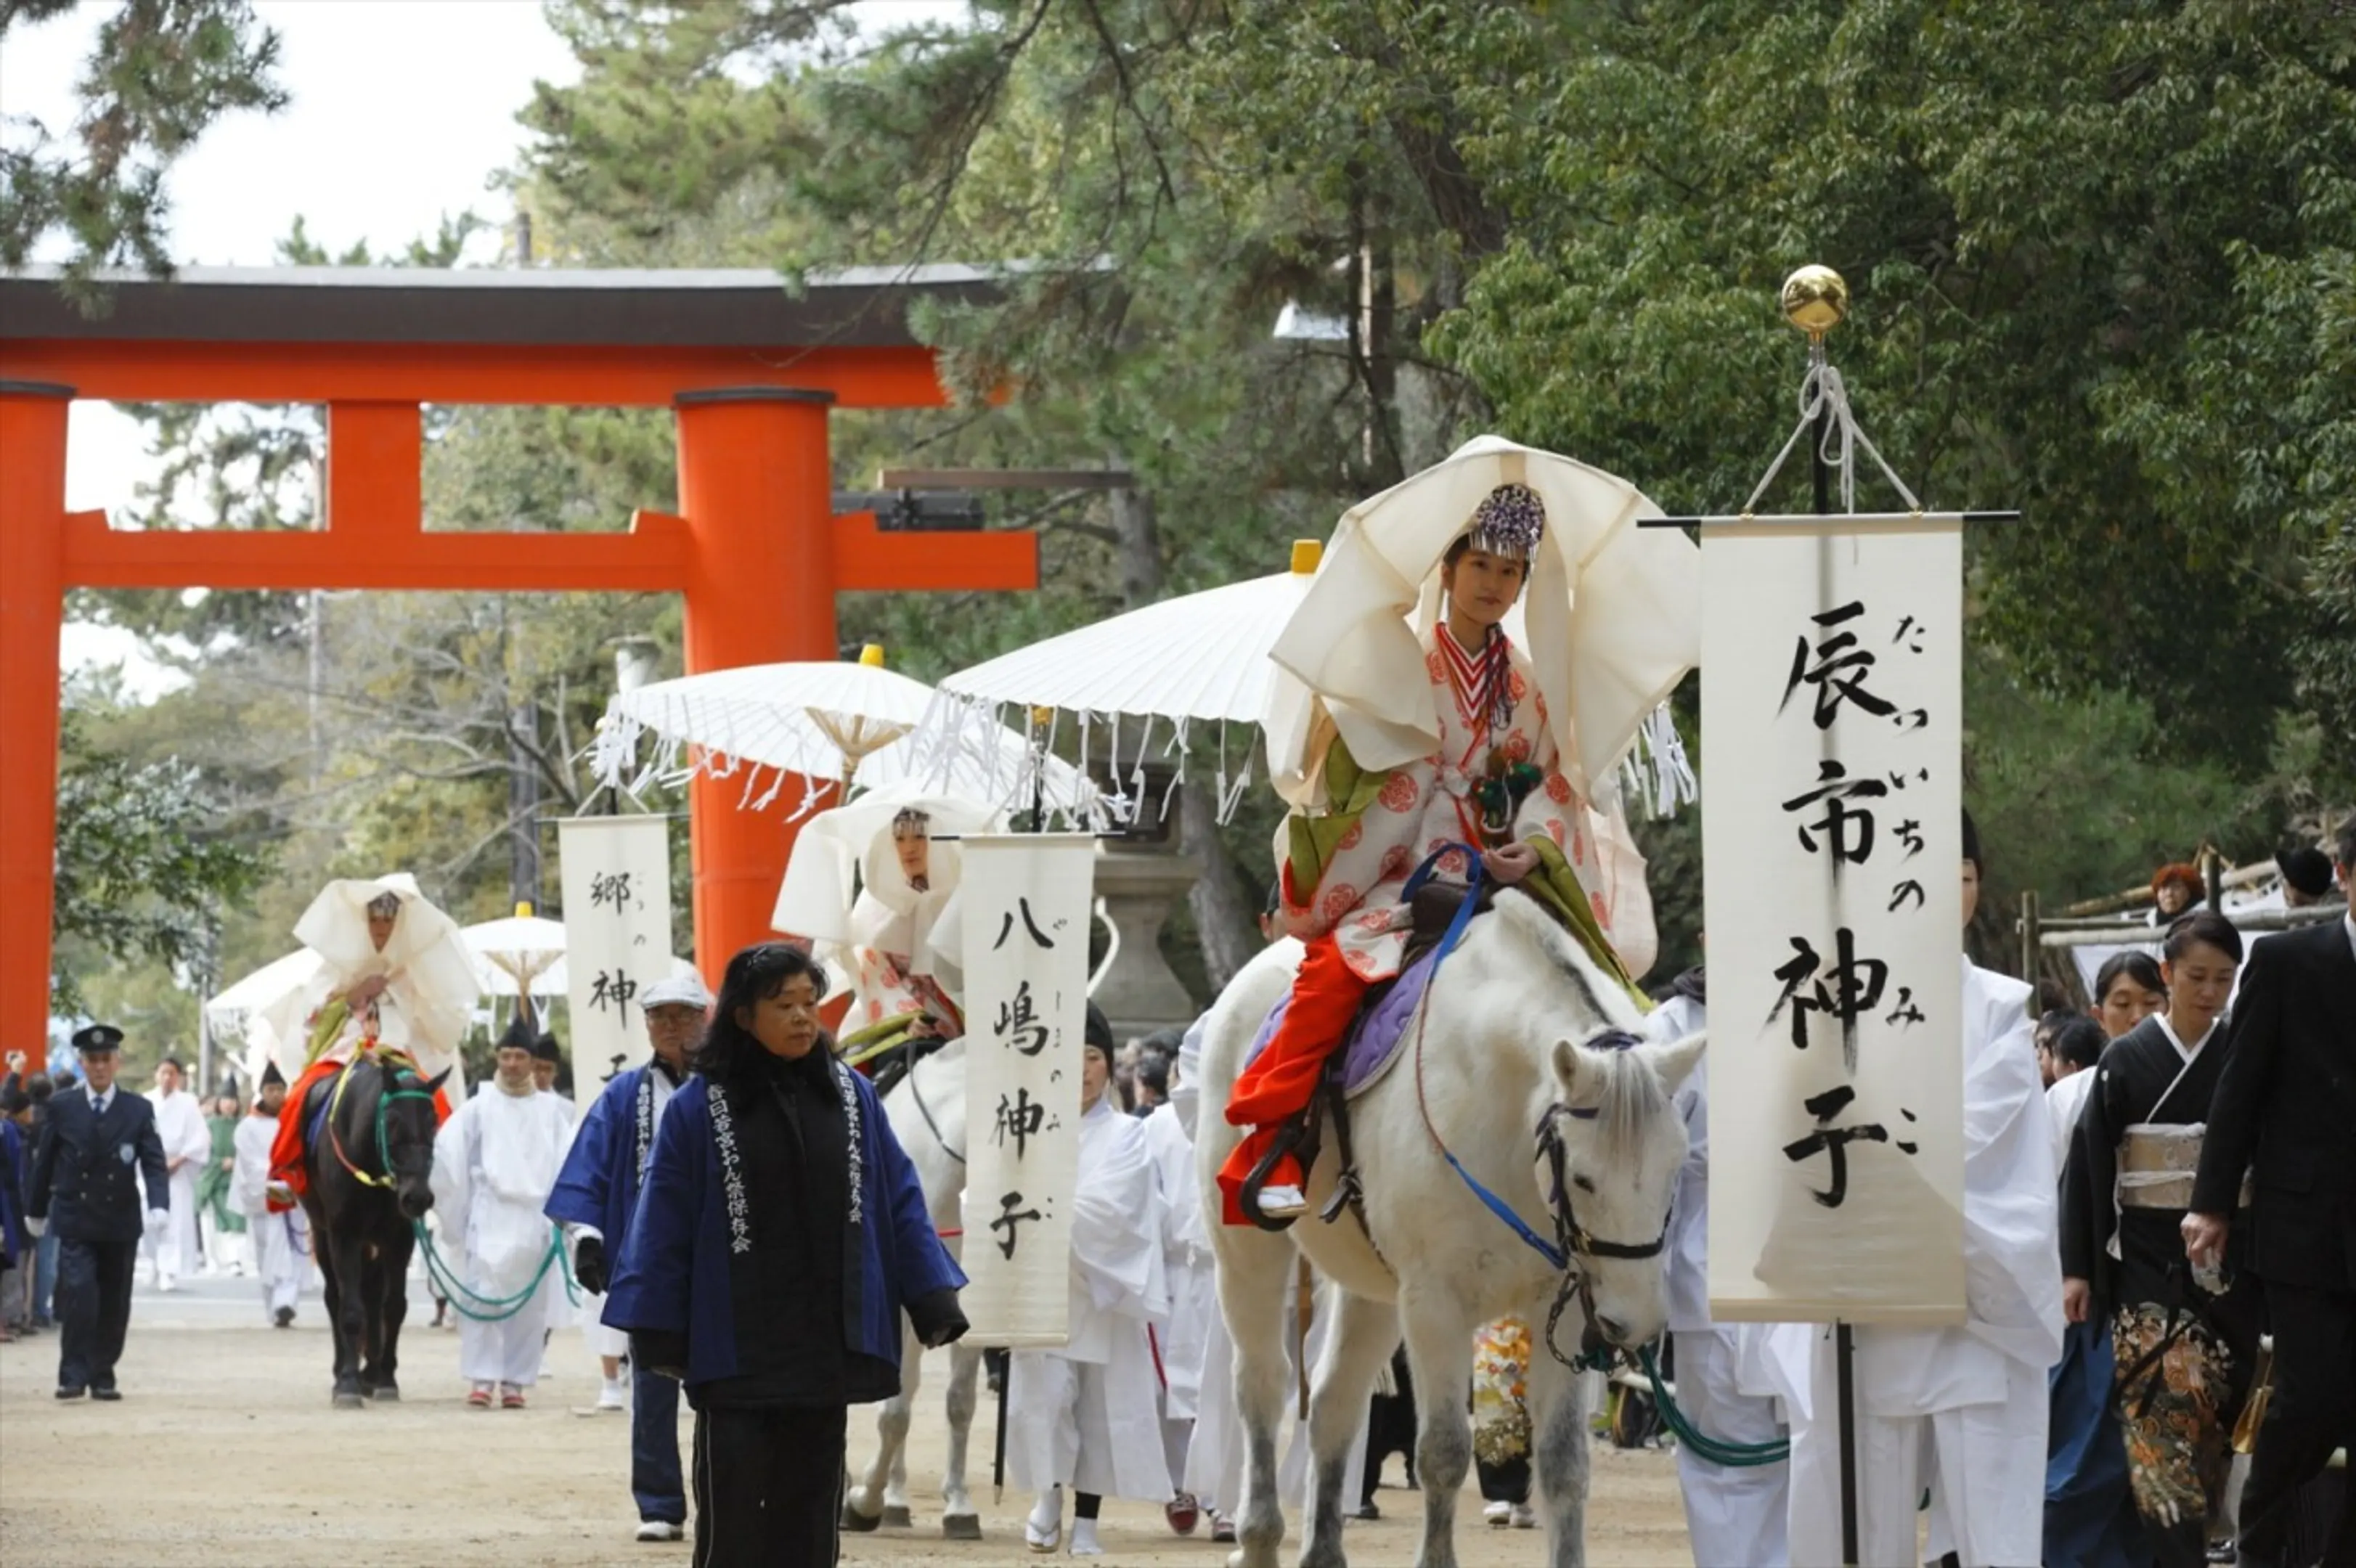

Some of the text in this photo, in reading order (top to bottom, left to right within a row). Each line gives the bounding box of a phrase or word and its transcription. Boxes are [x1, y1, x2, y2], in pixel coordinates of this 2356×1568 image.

[988, 897, 1055, 1262] 八嶋神子
[1761, 600, 1899, 1210] 辰市神子
